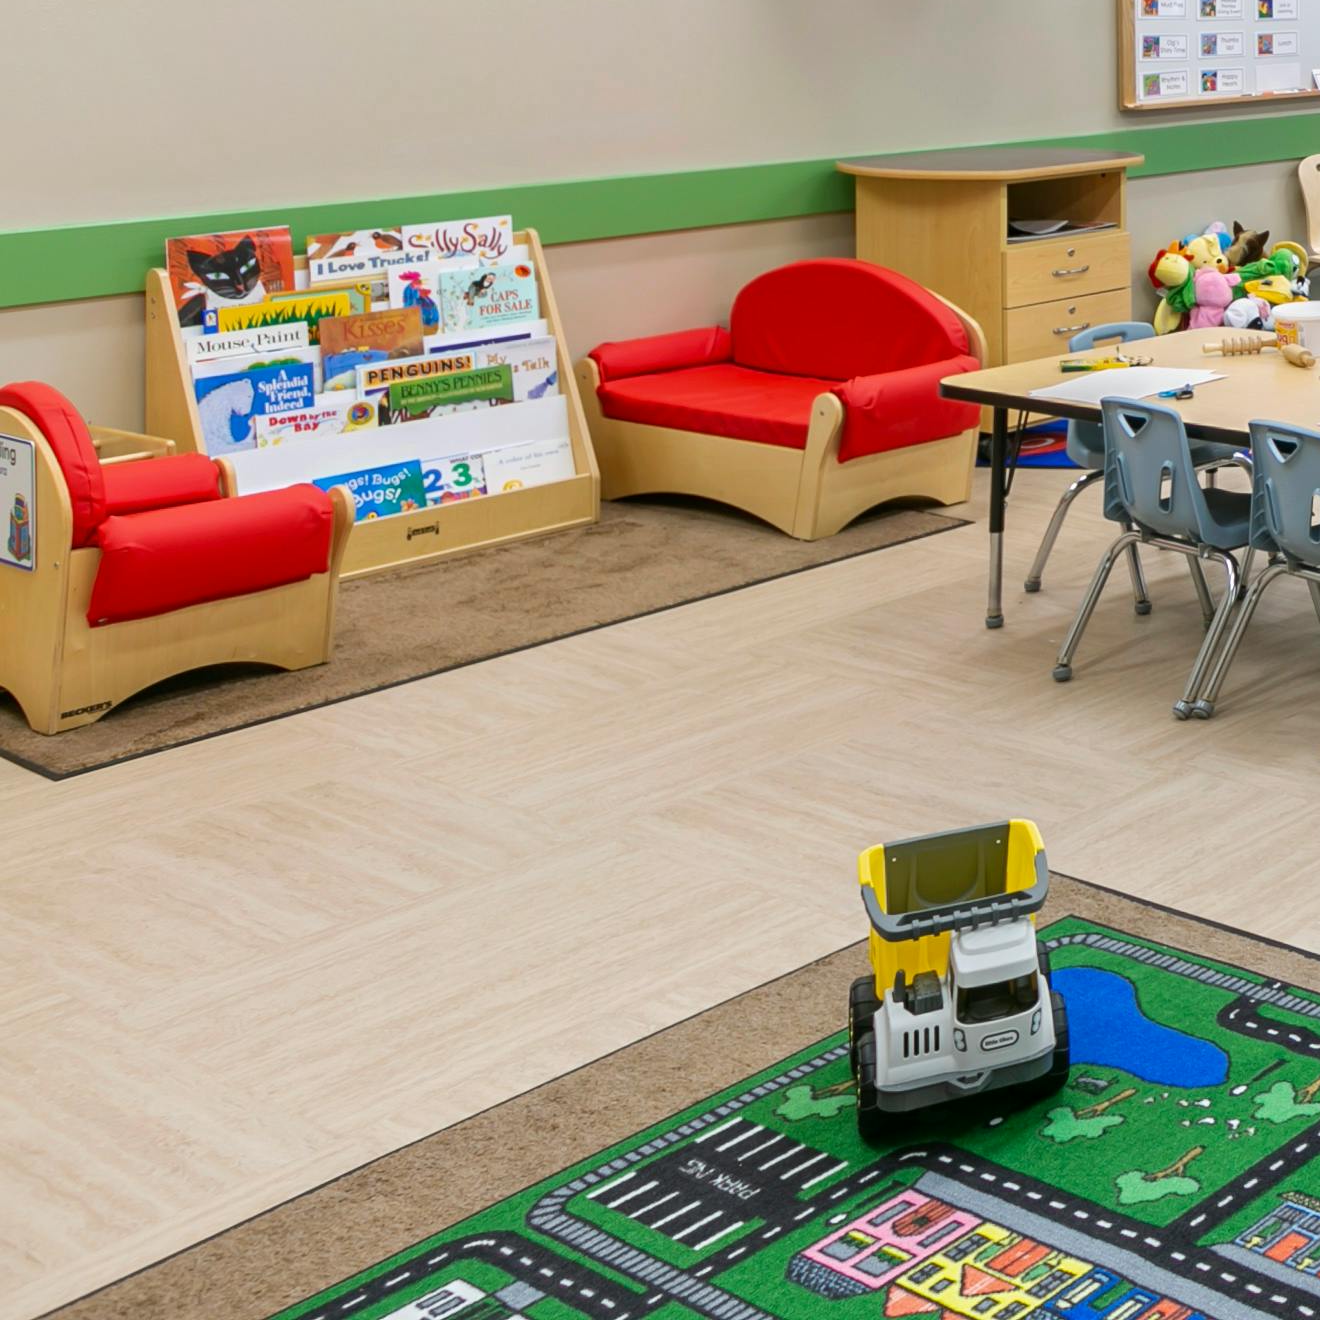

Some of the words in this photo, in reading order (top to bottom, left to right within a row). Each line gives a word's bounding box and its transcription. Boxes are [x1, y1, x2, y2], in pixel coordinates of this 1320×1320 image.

[408, 228, 459, 259] Silly
[460, 223, 508, 259] Sally
[317, 263, 323, 275] I
[328, 261, 365, 273] Love
[368, 250, 430, 268] Trucks!
[490, 289, 519, 302] CAPS
[480, 303, 501, 316] FOR
[504, 299, 533, 312] SALE
[343, 319, 405, 342] Kisses
[197, 338, 250, 355] Mouse
[256, 330, 301, 346] Paint
[279, 369, 288, 380] A
[368, 355, 472, 384] PENGUINS!
[258, 375, 308, 396] Splendid
[270, 386, 311, 403] Friend,
[400, 377, 450, 398] BENNY'S
[453, 369, 503, 390] PENNIES
[265, 397, 304, 414] Indeed
[372, 467, 412, 486] Bugs!
[451, 462, 473, 487] 3
